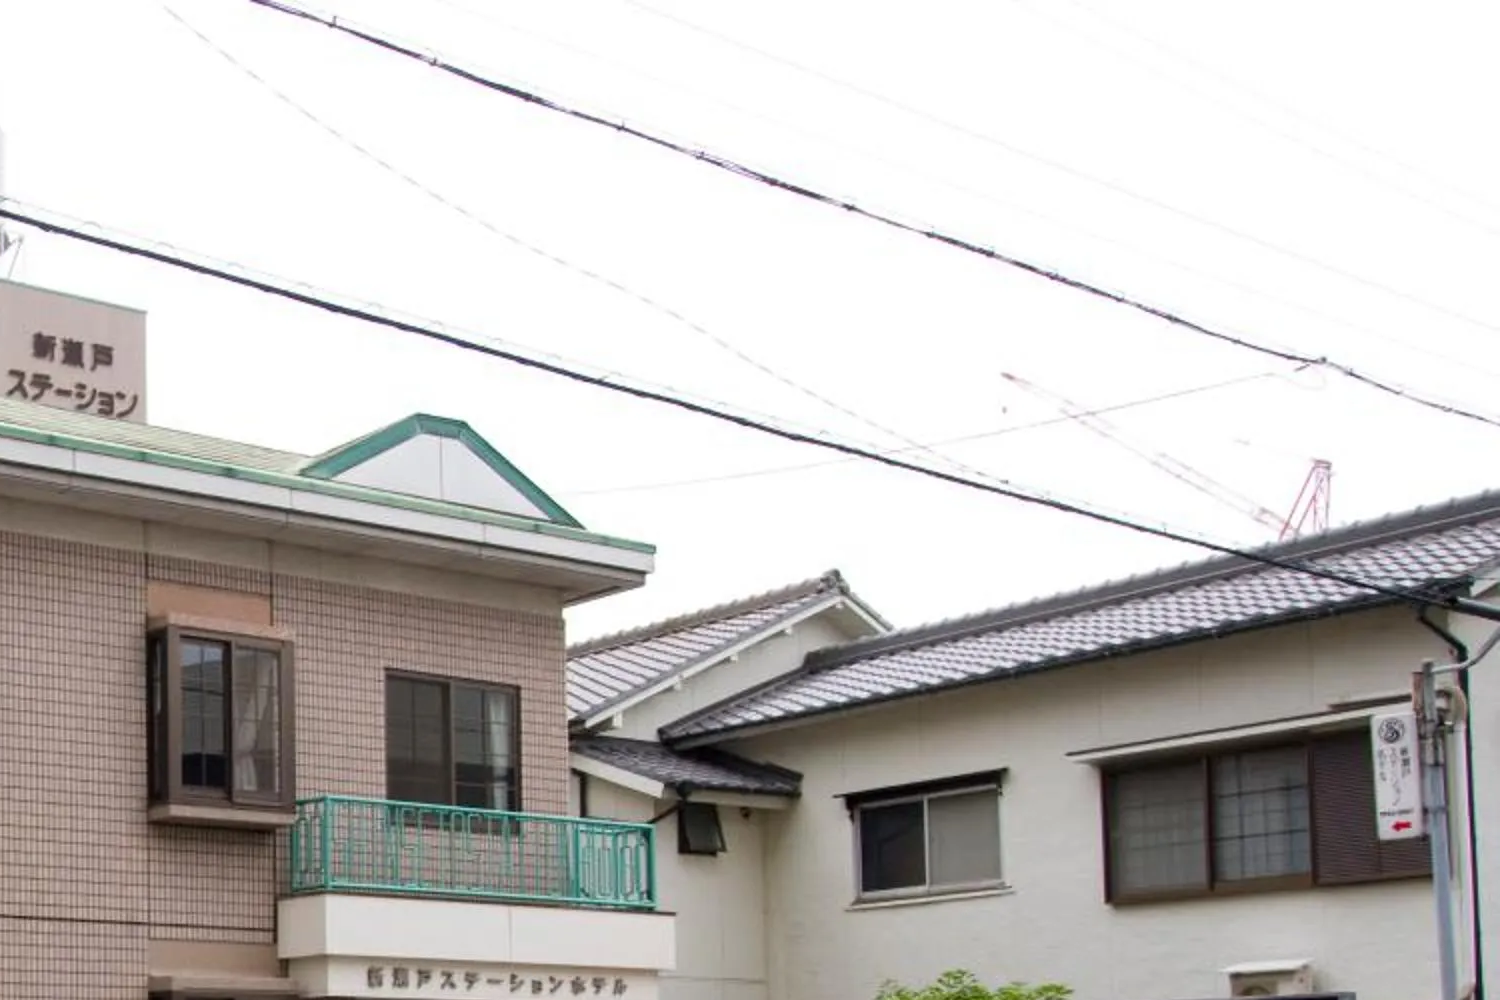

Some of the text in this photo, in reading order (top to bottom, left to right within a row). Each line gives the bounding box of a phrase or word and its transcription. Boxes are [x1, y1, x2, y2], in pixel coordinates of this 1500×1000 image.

[6, 368, 138, 418] ステーション
